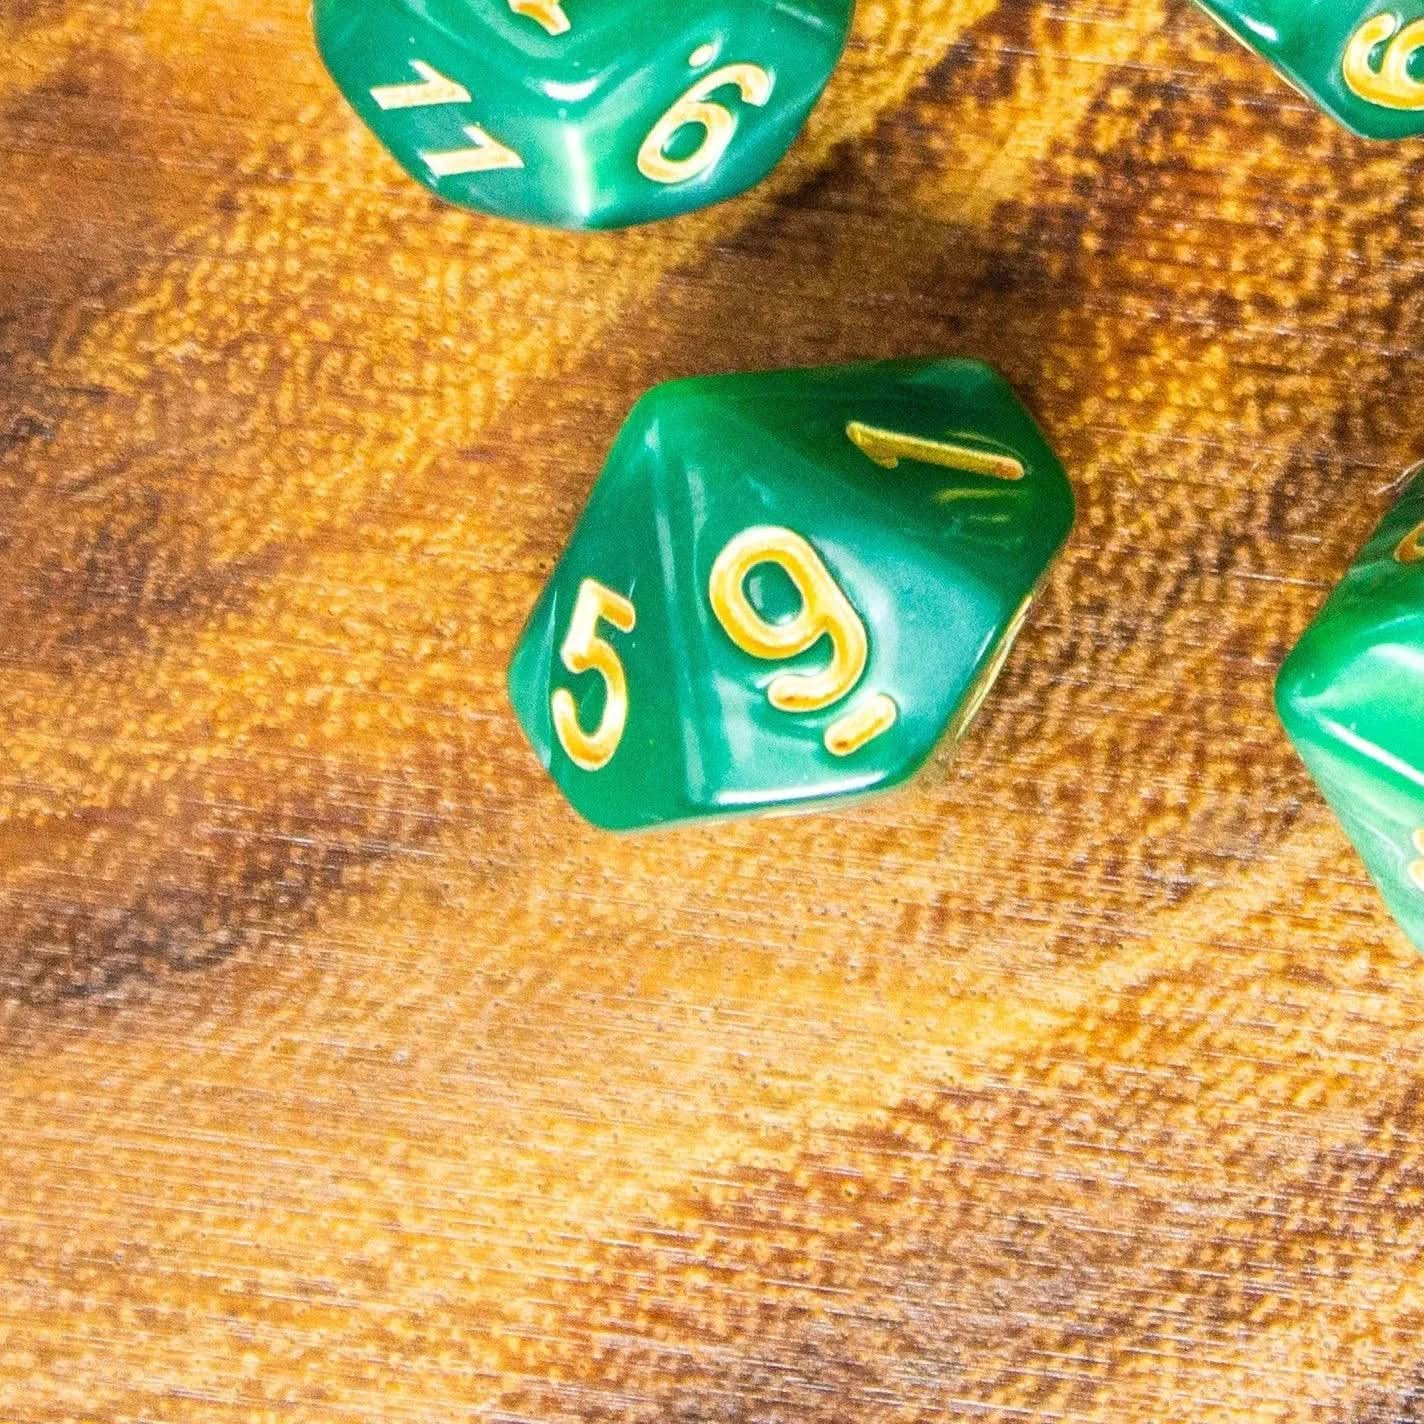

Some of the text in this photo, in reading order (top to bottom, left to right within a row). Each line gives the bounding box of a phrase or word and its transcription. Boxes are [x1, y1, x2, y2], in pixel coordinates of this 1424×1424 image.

[369, 60, 525, 176] 11
[846, 420, 1025, 481] 1
[552, 578, 636, 772] 5
